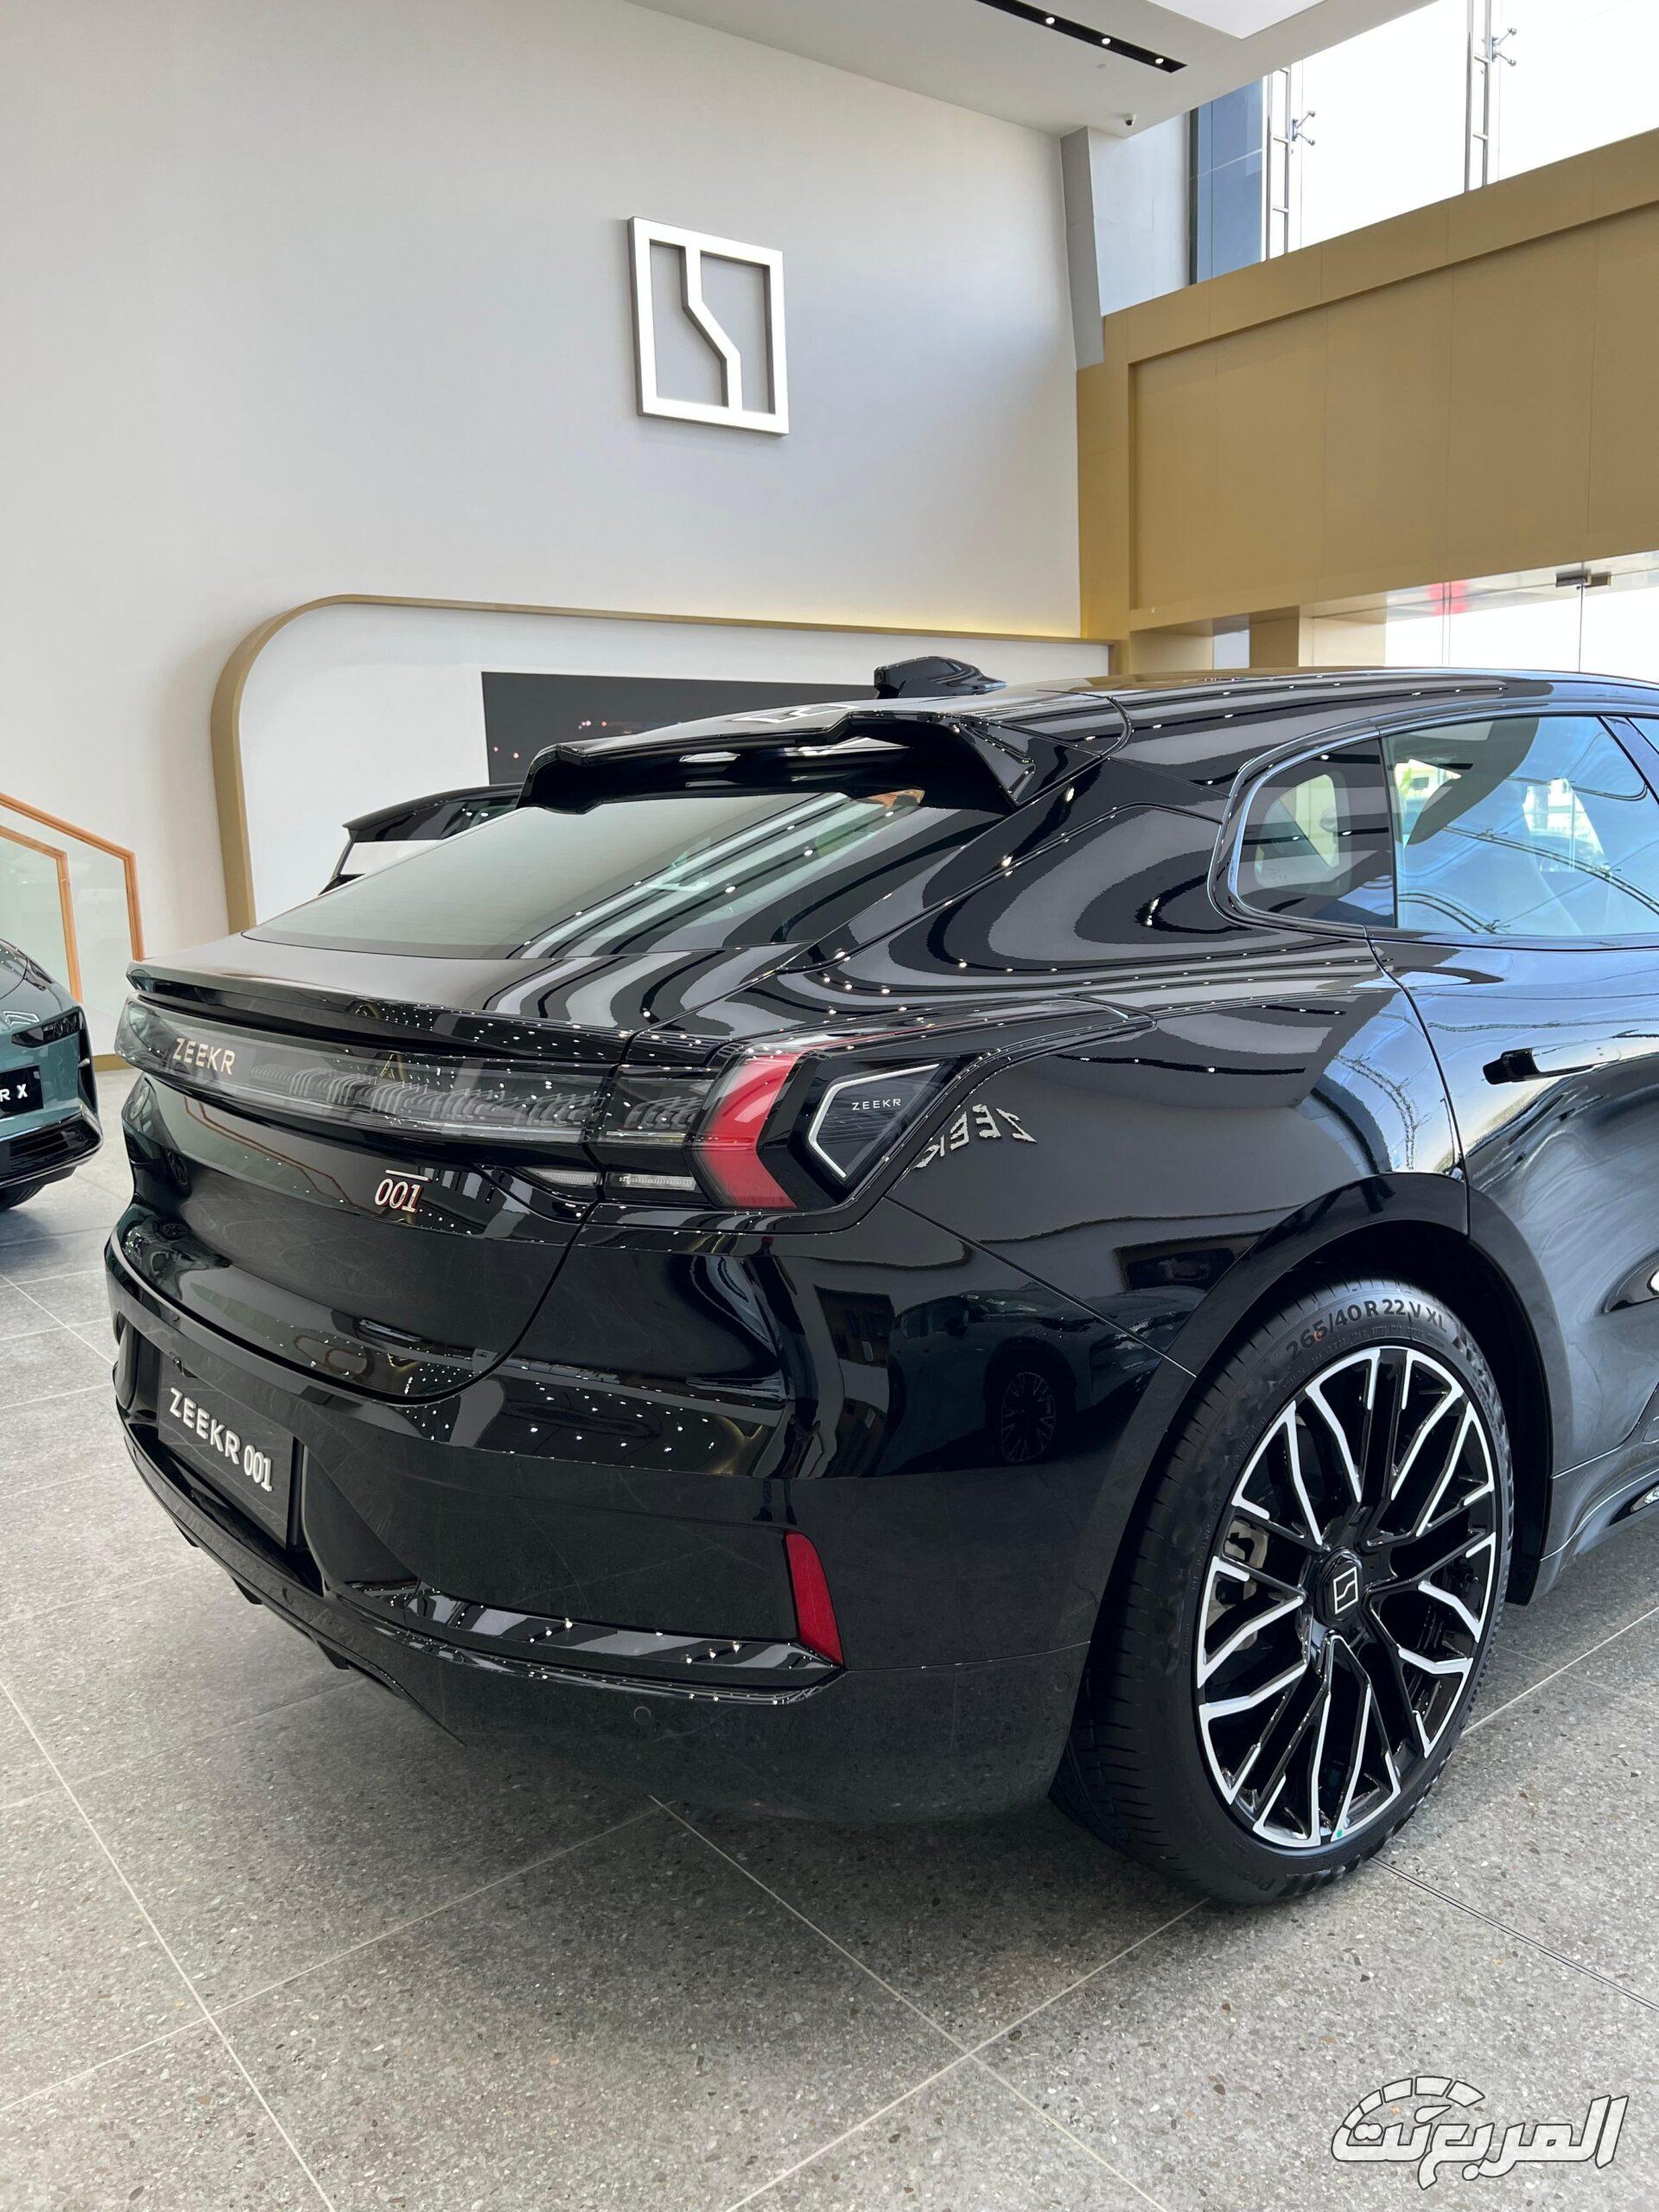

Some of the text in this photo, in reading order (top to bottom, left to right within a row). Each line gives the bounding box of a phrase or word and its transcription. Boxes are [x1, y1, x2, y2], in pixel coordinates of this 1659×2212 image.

[172, 1037, 236, 1076] ZEEKR
[16, 1084, 29, 1099] X
[851, 1098, 901, 1111] ZEEKR
[374, 1178, 422, 1213] 001
[169, 1387, 273, 1492] ZEEKR 001
